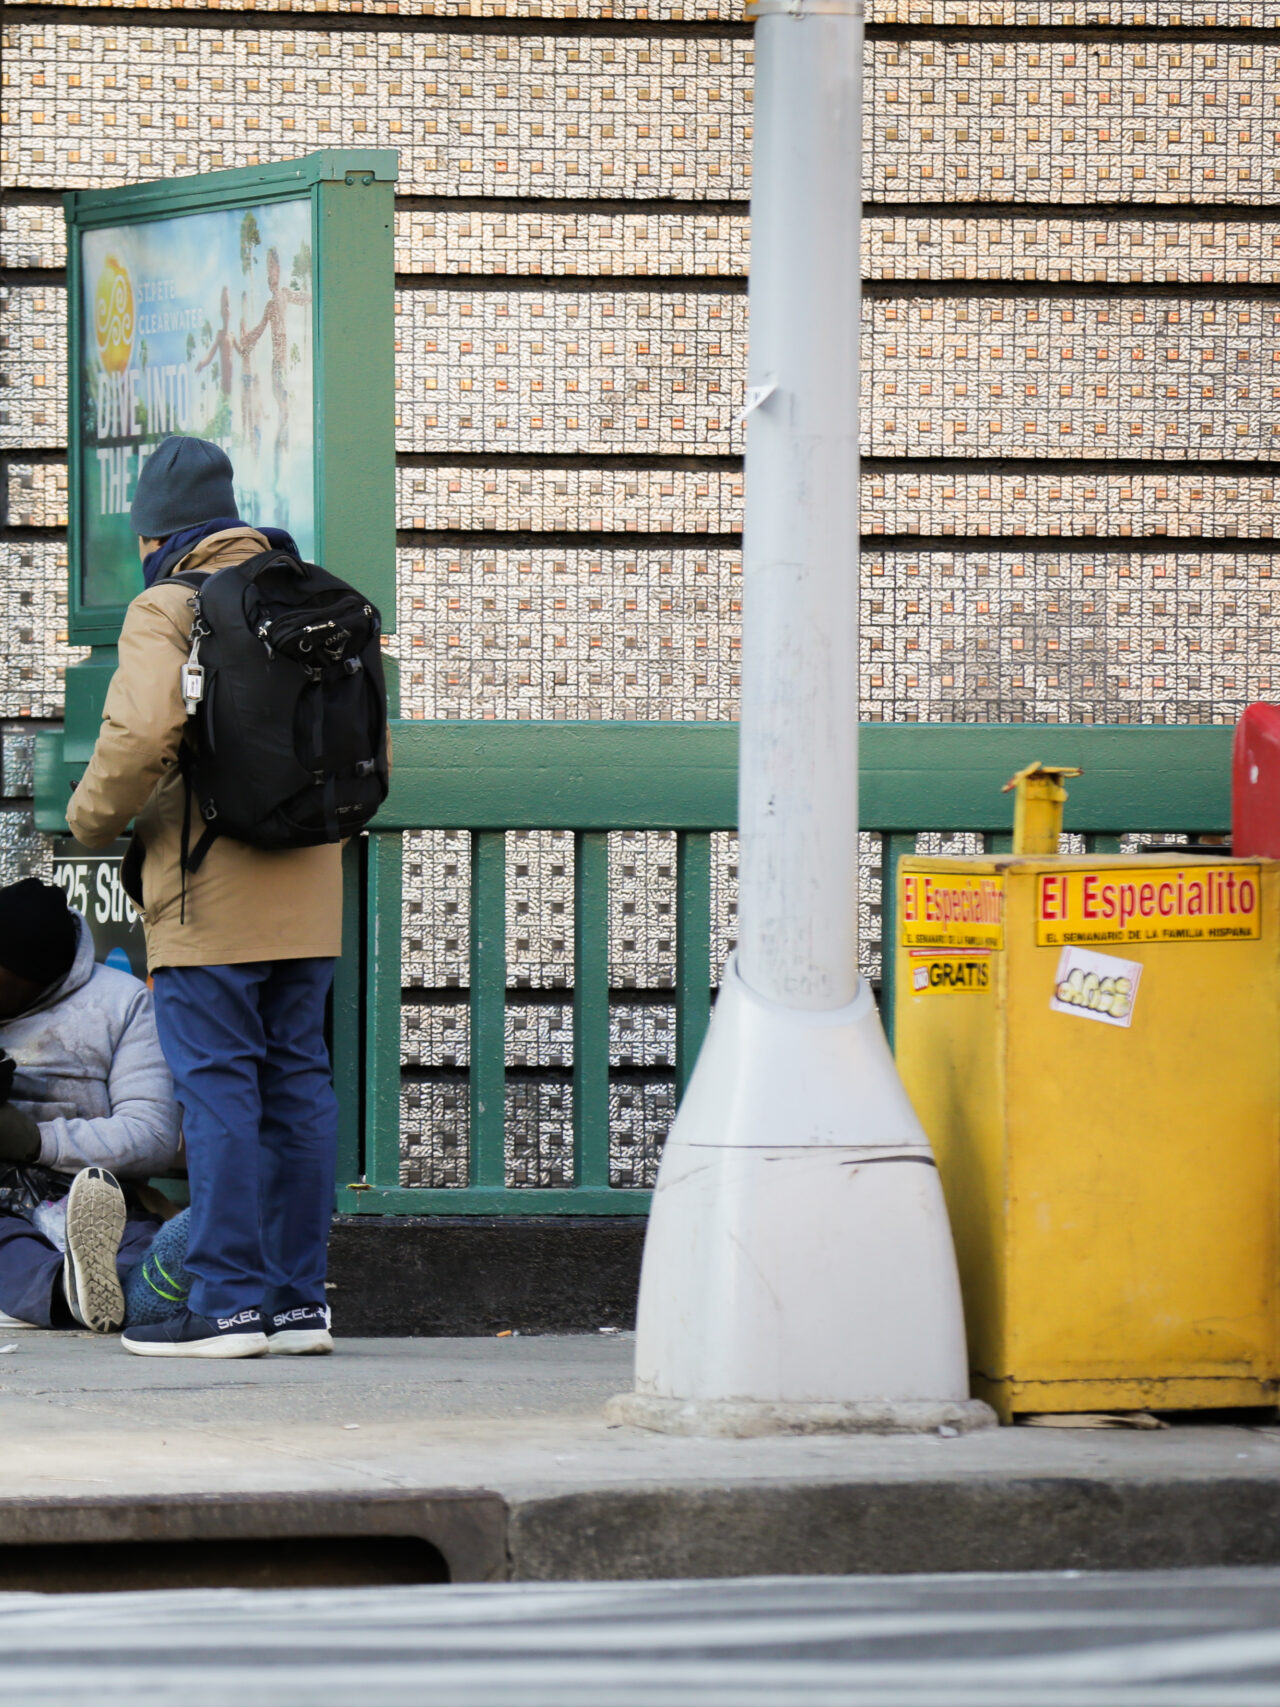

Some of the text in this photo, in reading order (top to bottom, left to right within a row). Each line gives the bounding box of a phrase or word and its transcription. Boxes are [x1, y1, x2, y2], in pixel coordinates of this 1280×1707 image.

[138, 308, 203, 335] CLEARWATER
[97, 363, 189, 439] DIVE INTO
[96, 445, 132, 515] THE
[95, 862, 144, 923] Stre
[904, 877, 918, 922] El
[1041, 871, 1256, 929] El Especialito
[1046, 926, 1253, 943] EL SEMANARIO DE LA FAMILIA HISPANA
[930, 963, 988, 987] GRATIS
[217, 1309, 260, 1330] SKEC
[274, 1307, 318, 1327] SKEC
